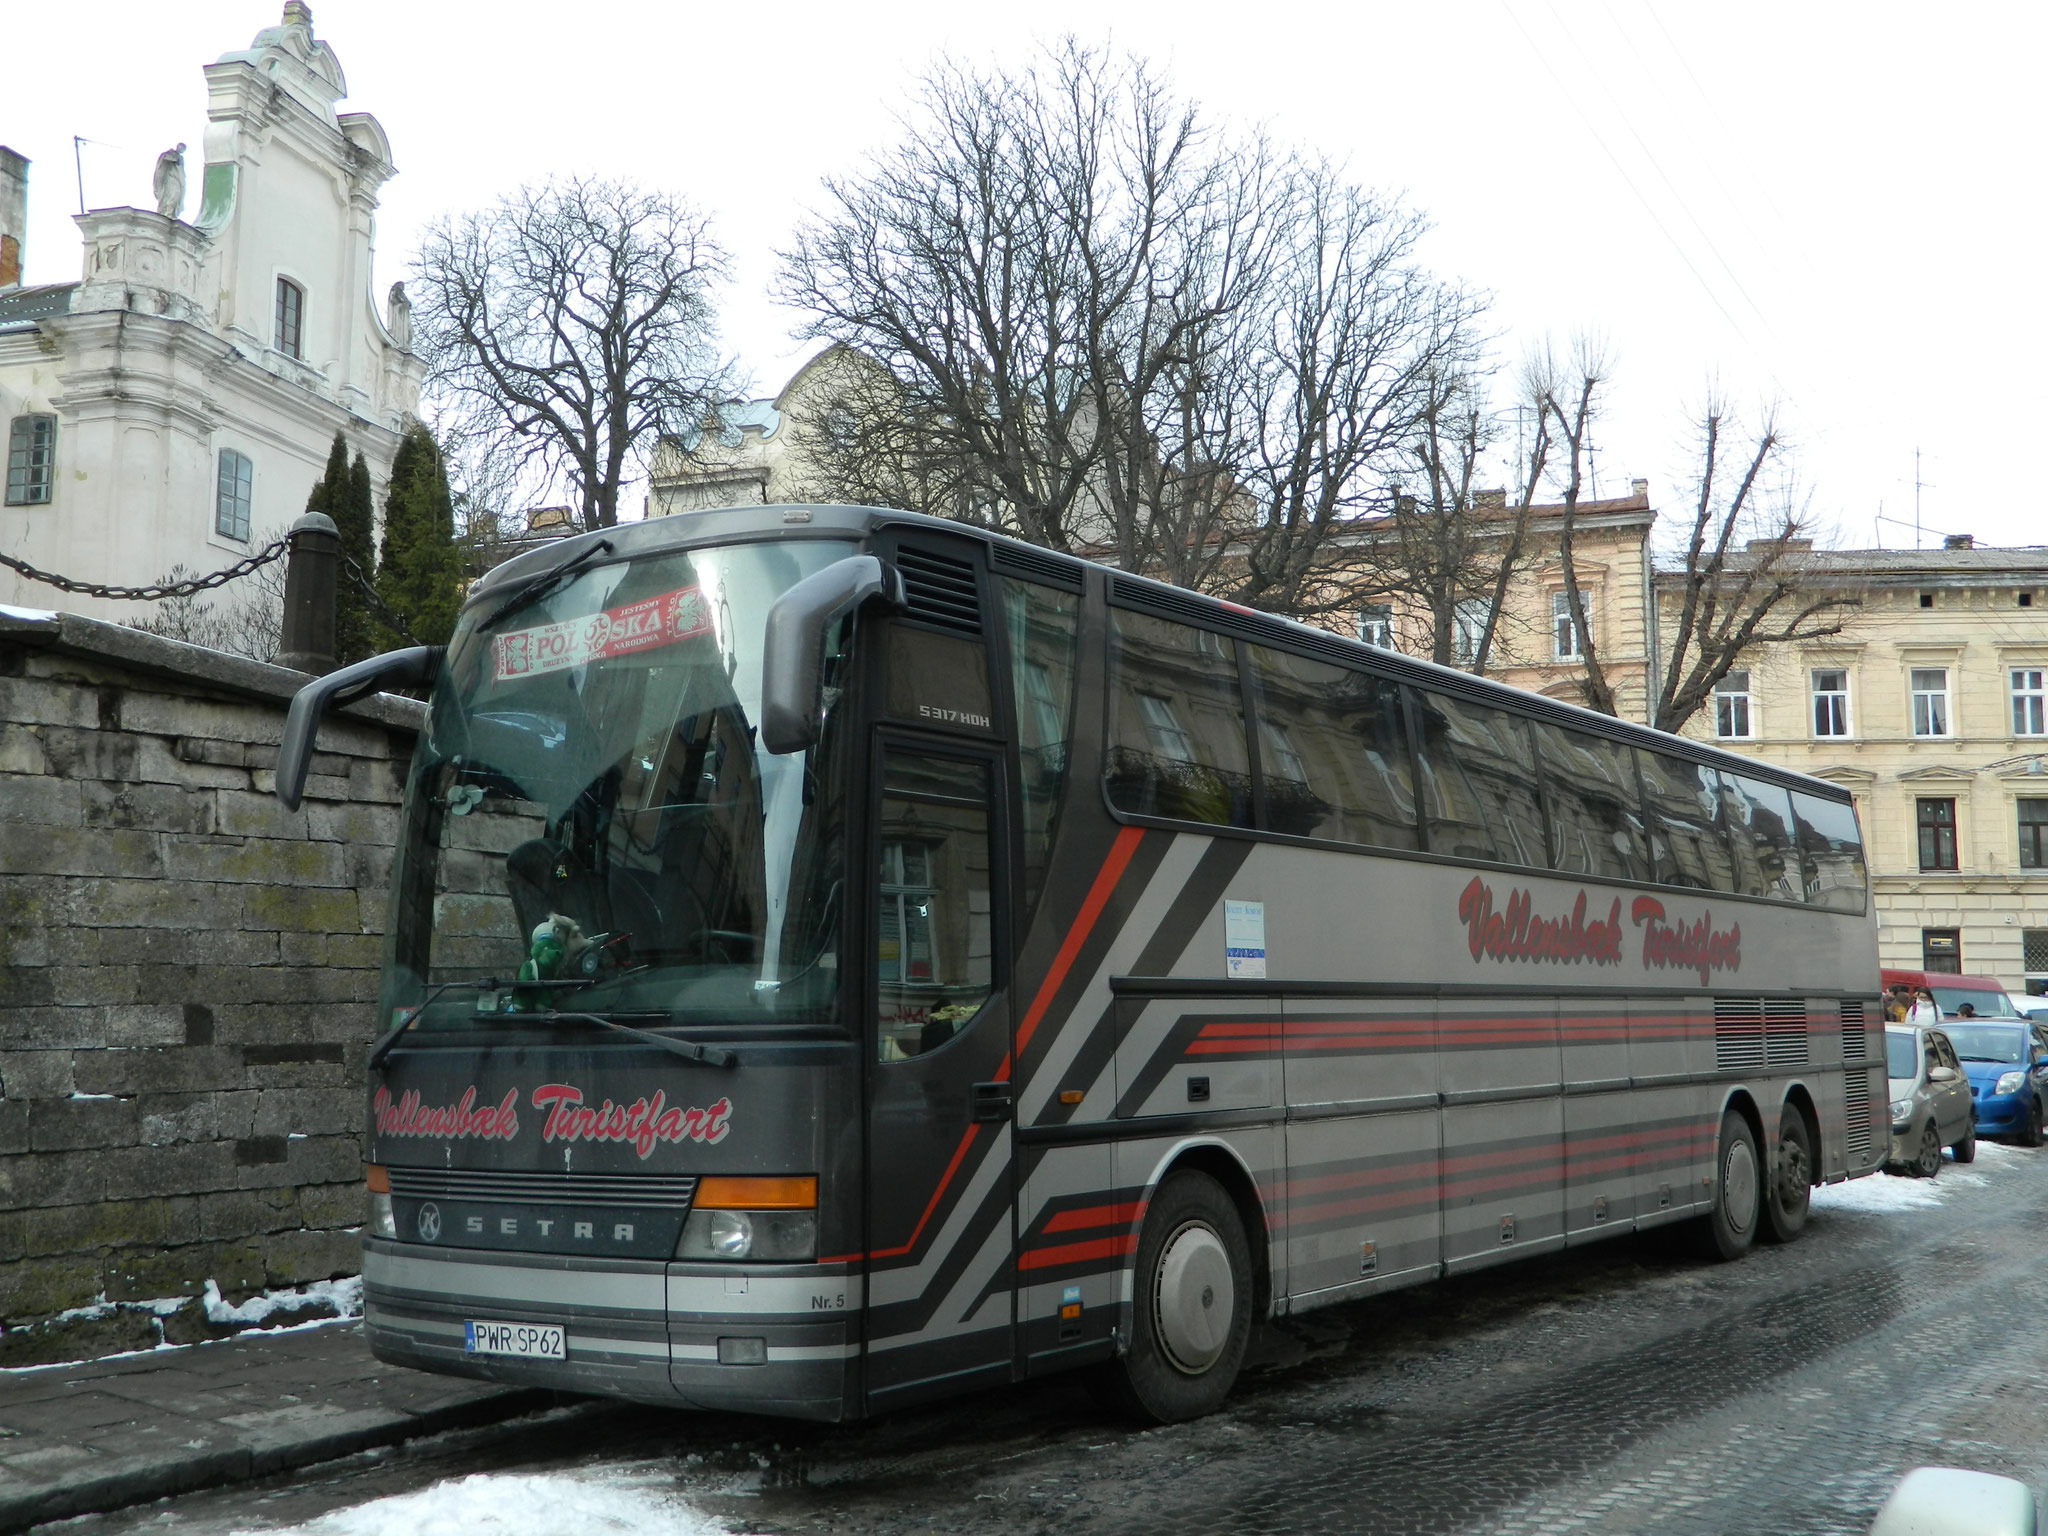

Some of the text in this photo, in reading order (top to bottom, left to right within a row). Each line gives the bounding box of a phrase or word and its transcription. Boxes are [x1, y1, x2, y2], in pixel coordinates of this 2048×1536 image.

[613, 633, 660, 650] NARODOWA
[932, 707, 957, 721] 317
[1632, 895, 1741, 987] Turistfart
[531, 1084, 734, 1160] Turistfart
[466, 1216, 634, 1241] SETRA
[811, 1294, 845, 1309] Nr. 5
[476, 1324, 561, 1355] PWR SP62
